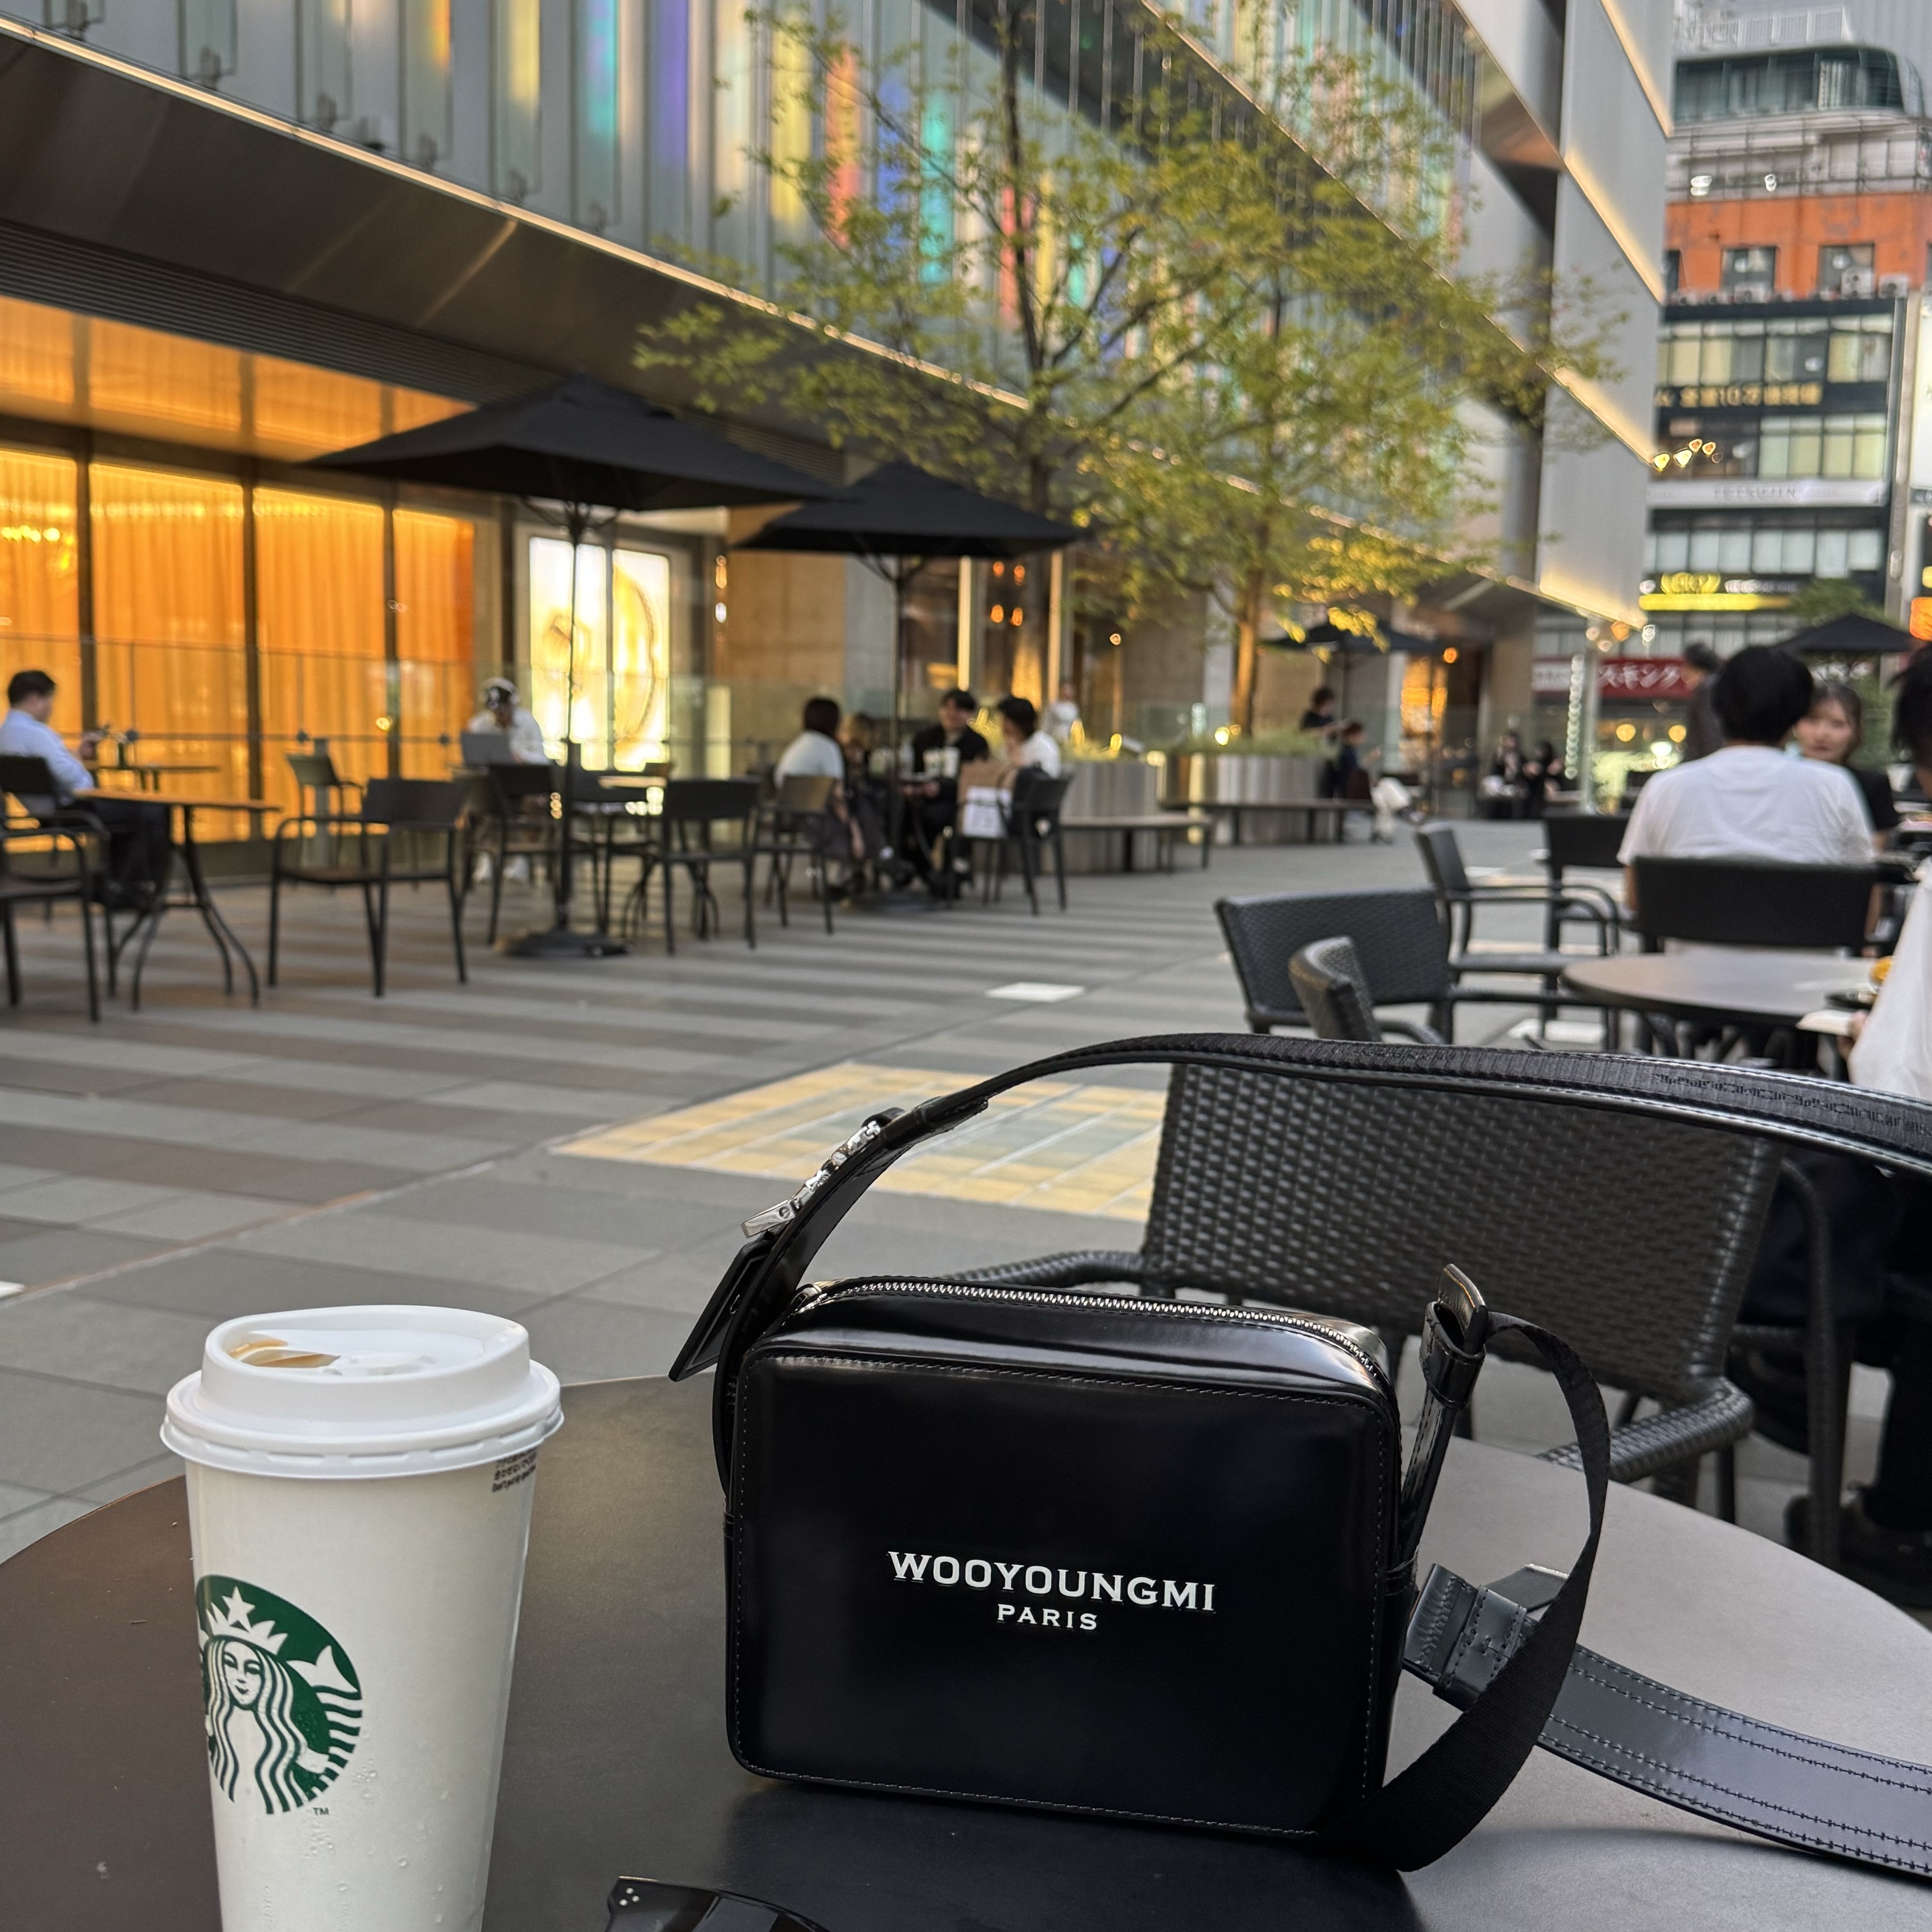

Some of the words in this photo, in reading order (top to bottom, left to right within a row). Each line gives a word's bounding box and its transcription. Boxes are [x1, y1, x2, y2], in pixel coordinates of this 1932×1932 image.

[887, 1550, 1216, 1611] WOOYOUNGMI
[997, 1603, 1098, 1631] PARIS
[313, 1807, 329, 1816] TM
